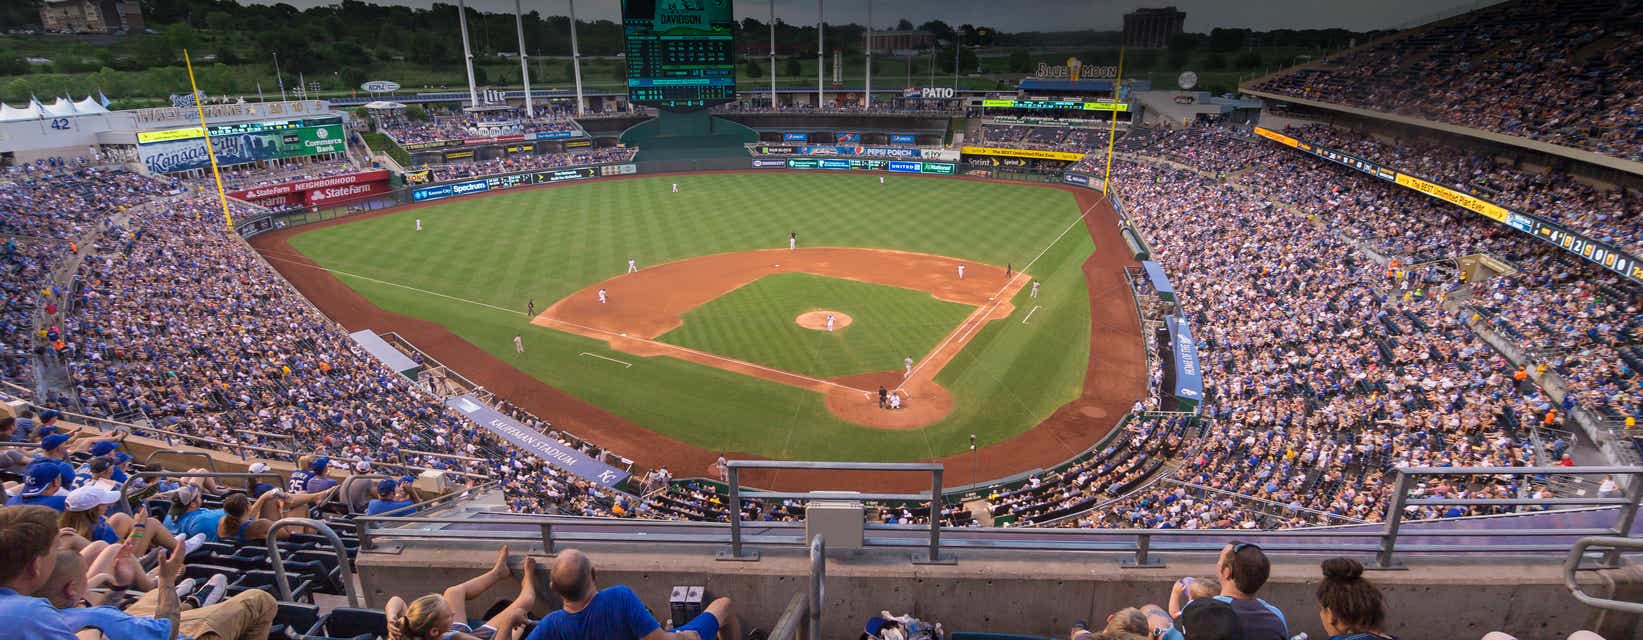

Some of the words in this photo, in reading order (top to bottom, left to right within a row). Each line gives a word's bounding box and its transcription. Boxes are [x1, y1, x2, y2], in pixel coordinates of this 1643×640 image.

[661, 15, 702, 24] DAVIDSON
[1081, 65, 1118, 77] MOON
[483, 88, 506, 105] Lite
[922, 87, 954, 98] PATIO
[51, 118, 71, 130] 42
[304, 138, 342, 147] Commerce
[316, 145, 335, 153] Bank
[867, 148, 887, 156] PEPSI
[887, 149, 912, 157] PORCH
[146, 144, 207, 173] Kansas
[295, 175, 356, 191] NEIGHBORHOOD
[453, 182, 485, 193] Spectrum
[1421, 183, 1434, 192] BEST
[1550, 230, 1559, 241] 4
[1574, 240, 1582, 252] 2
[1595, 249, 1603, 260] 0
[1617, 259, 1626, 271] 0
[489, 418, 533, 444] KAUFFMAN
[532, 441, 577, 467] STADIUM
[25, 475, 36, 485] KC
[598, 469, 617, 483] KC
[289, 479, 305, 493] 35
